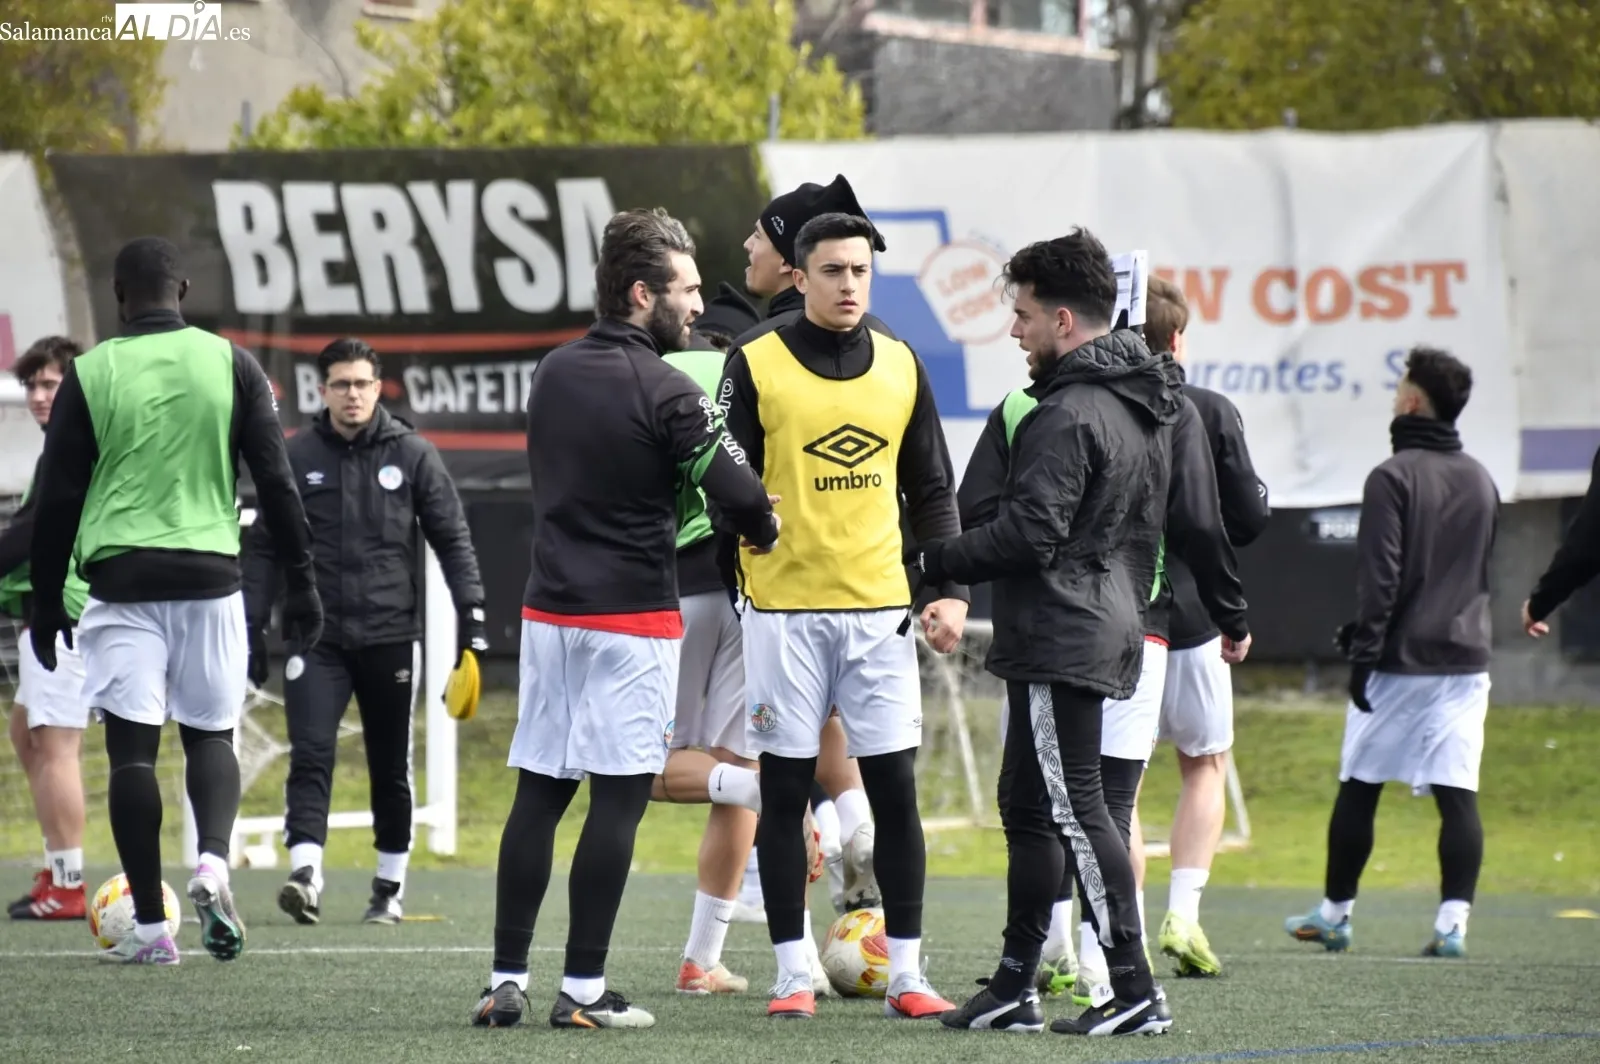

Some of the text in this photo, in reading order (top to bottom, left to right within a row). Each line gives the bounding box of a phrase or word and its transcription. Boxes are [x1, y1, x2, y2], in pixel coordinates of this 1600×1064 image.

[212, 177, 617, 315] BERYSA
[1152, 268, 1232, 324] W
[1250, 260, 1466, 326] COST
[814, 470, 882, 492] umbro
